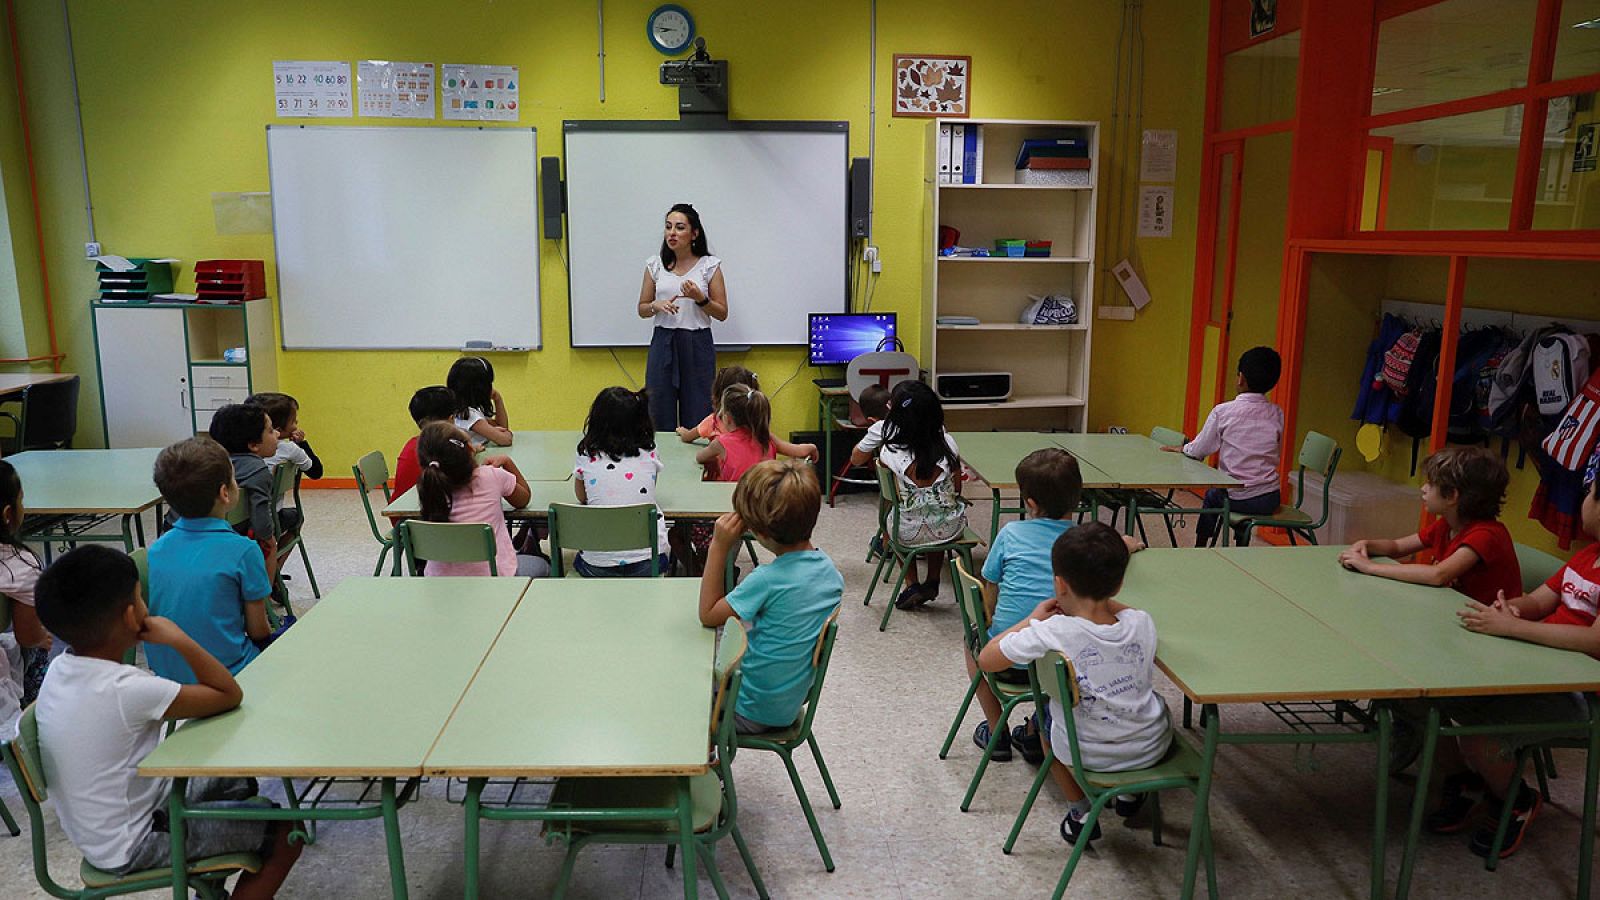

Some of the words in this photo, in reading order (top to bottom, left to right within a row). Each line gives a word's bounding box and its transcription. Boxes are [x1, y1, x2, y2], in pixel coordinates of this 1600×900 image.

[286, 74, 294, 84] 16
[298, 74, 307, 84] 22
[313, 75, 324, 84] 40
[325, 75, 336, 85] 60
[337, 75, 347, 85] 80
[279, 99, 288, 109] 53
[293, 99, 302, 109] 71
[309, 99, 318, 109] 34
[338, 99, 348, 109] 90
[1540, 395, 1562, 405] MADRID
[1109, 675, 1133, 688] VAMOS
